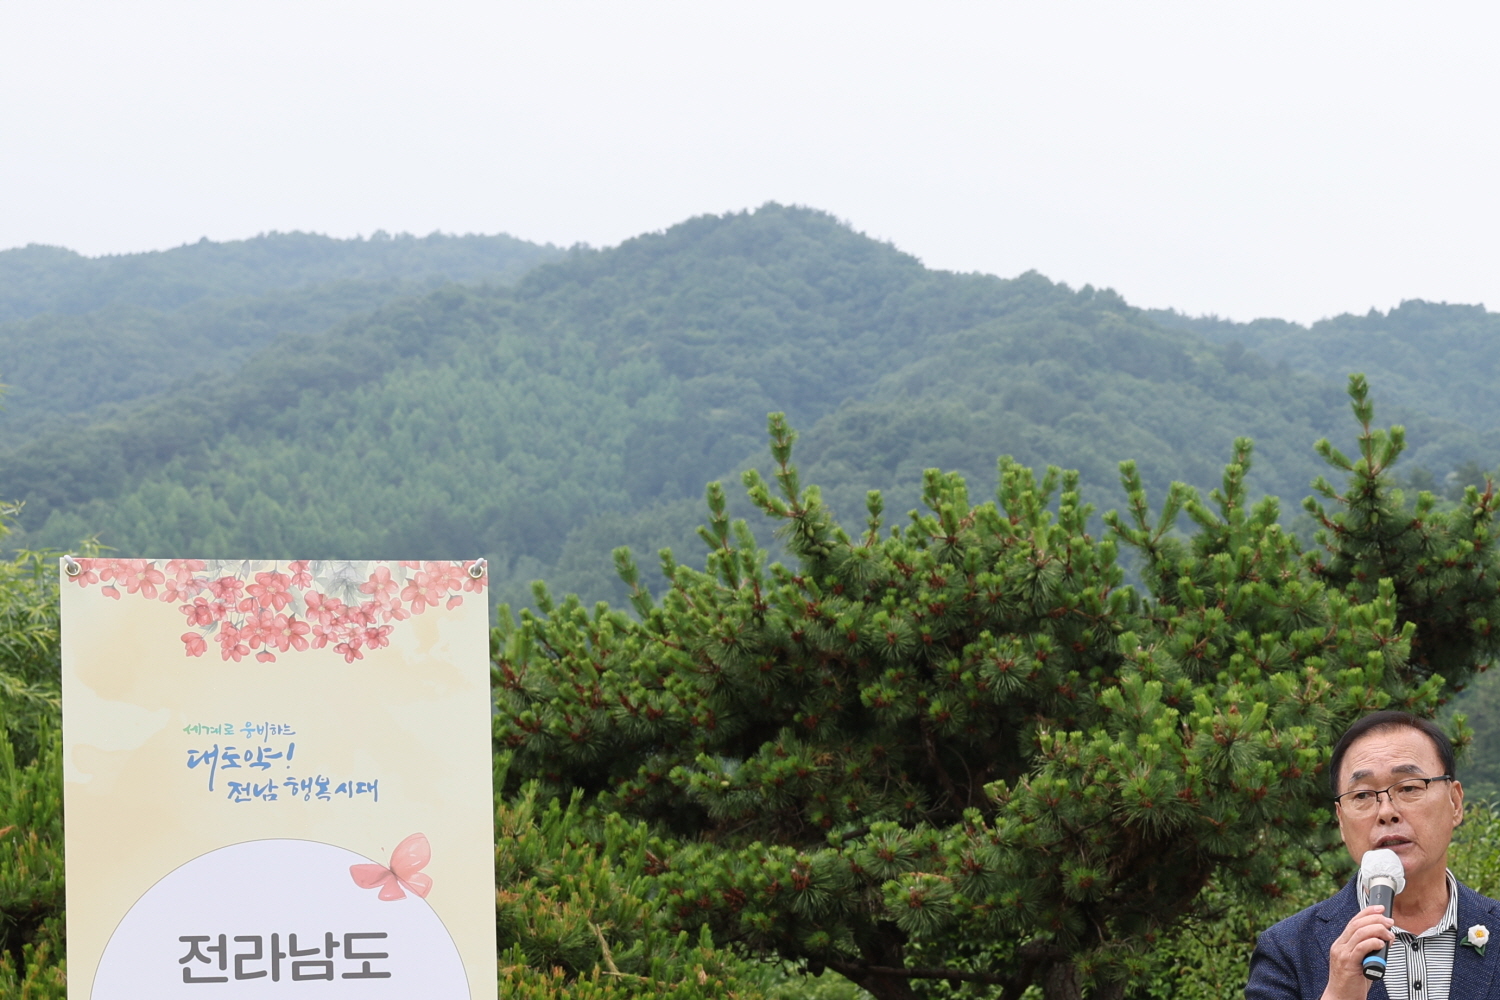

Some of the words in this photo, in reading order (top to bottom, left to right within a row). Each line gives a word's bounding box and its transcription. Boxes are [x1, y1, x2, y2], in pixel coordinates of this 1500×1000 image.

[183, 722, 235, 736] 세계로
[186, 742, 296, 792] 대도약!
[227, 778, 279, 803] 전남
[178, 931, 392, 984] 전라남도
